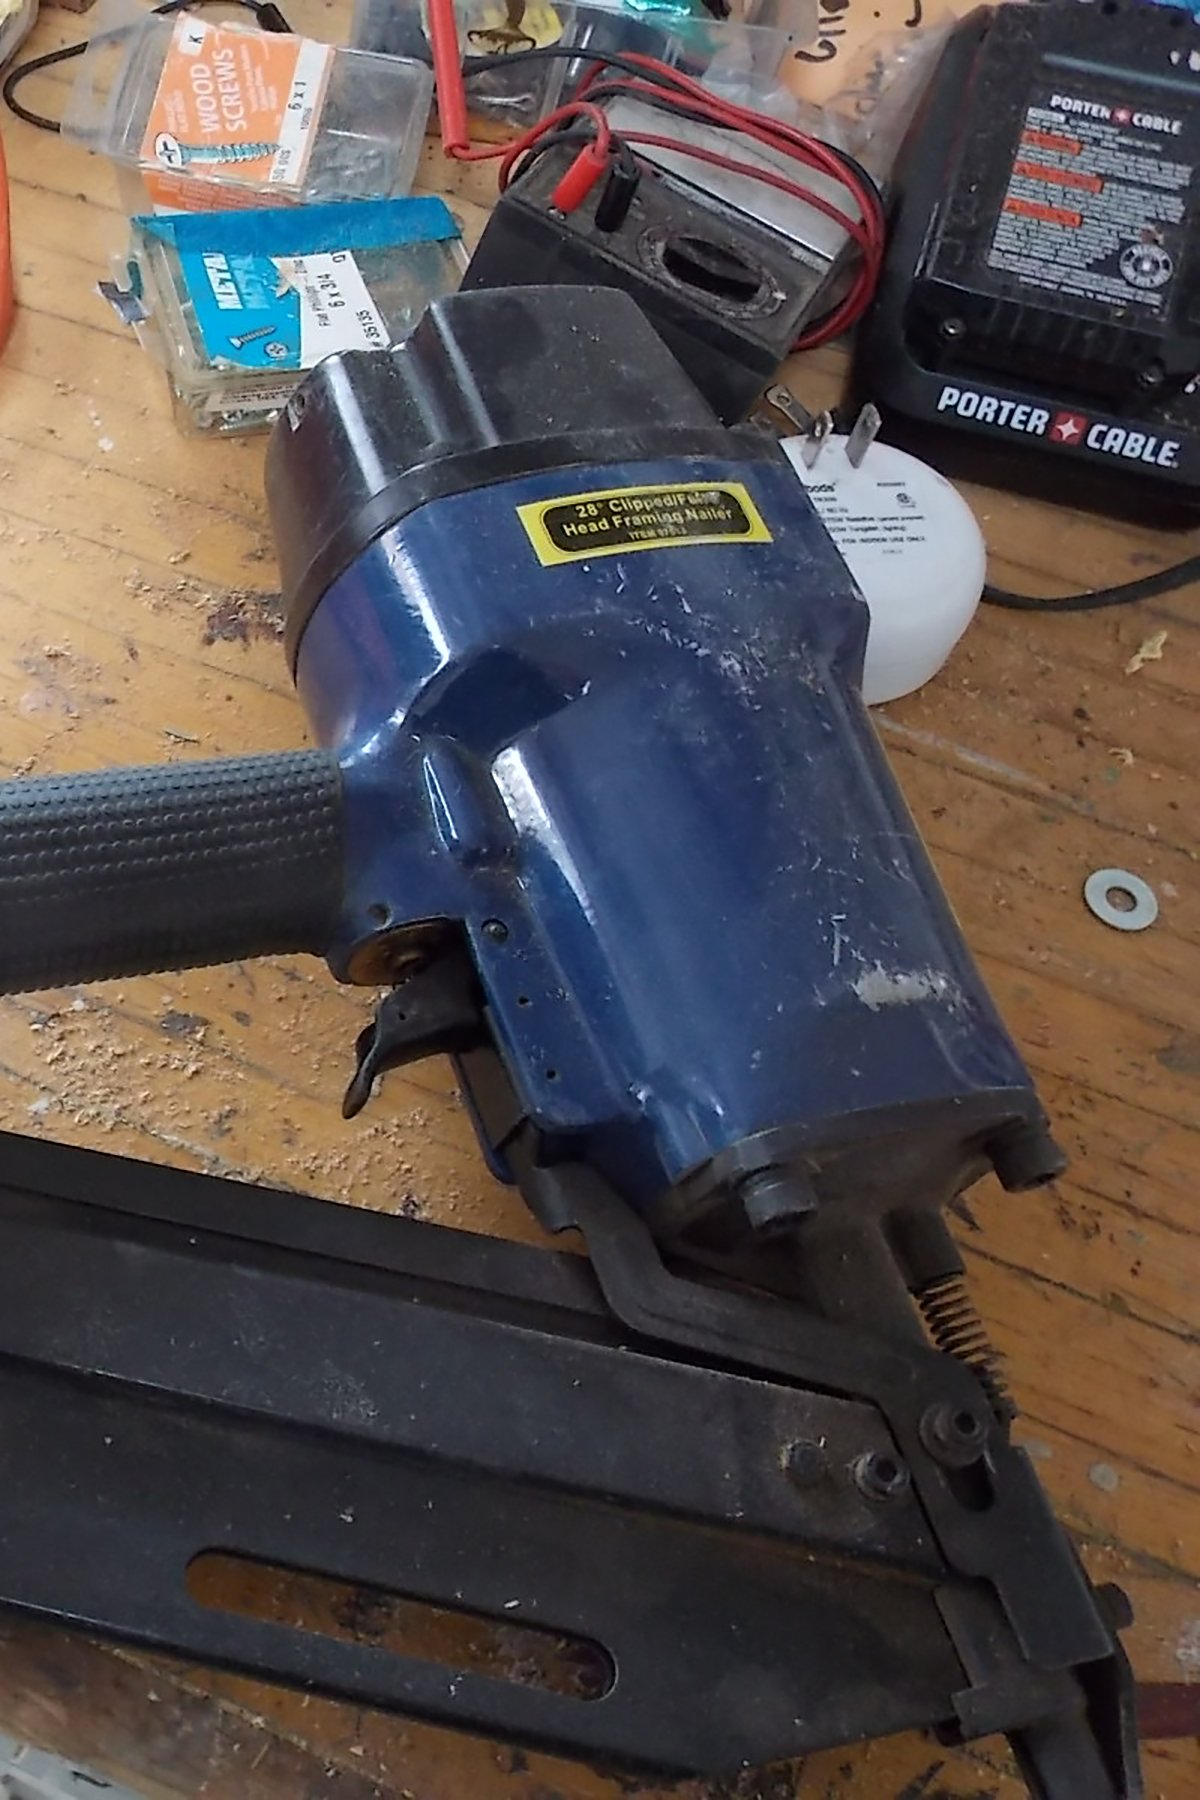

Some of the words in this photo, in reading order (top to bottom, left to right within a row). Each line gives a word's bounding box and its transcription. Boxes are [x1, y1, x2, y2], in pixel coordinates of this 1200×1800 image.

[188, 34, 204, 44] K
[189, 63, 221, 133] WOOD
[212, 48, 247, 131] SCREWS
[288, 103, 302, 111] 6
[1050, 94, 1112, 120] PORTER
[1132, 112, 1183, 136] CABLE
[316, 273, 337, 290] 3/4
[328, 299, 346, 310] 6
[329, 291, 341, 299] x
[937, 386, 1050, 436] PORTER
[1086, 423, 1180, 468] CABLE
[608, 491, 721, 513] Clipped/Fu
[562, 518, 610, 537] Head
[612, 510, 684, 529] Framing
[685, 506, 733, 522] Nailer
